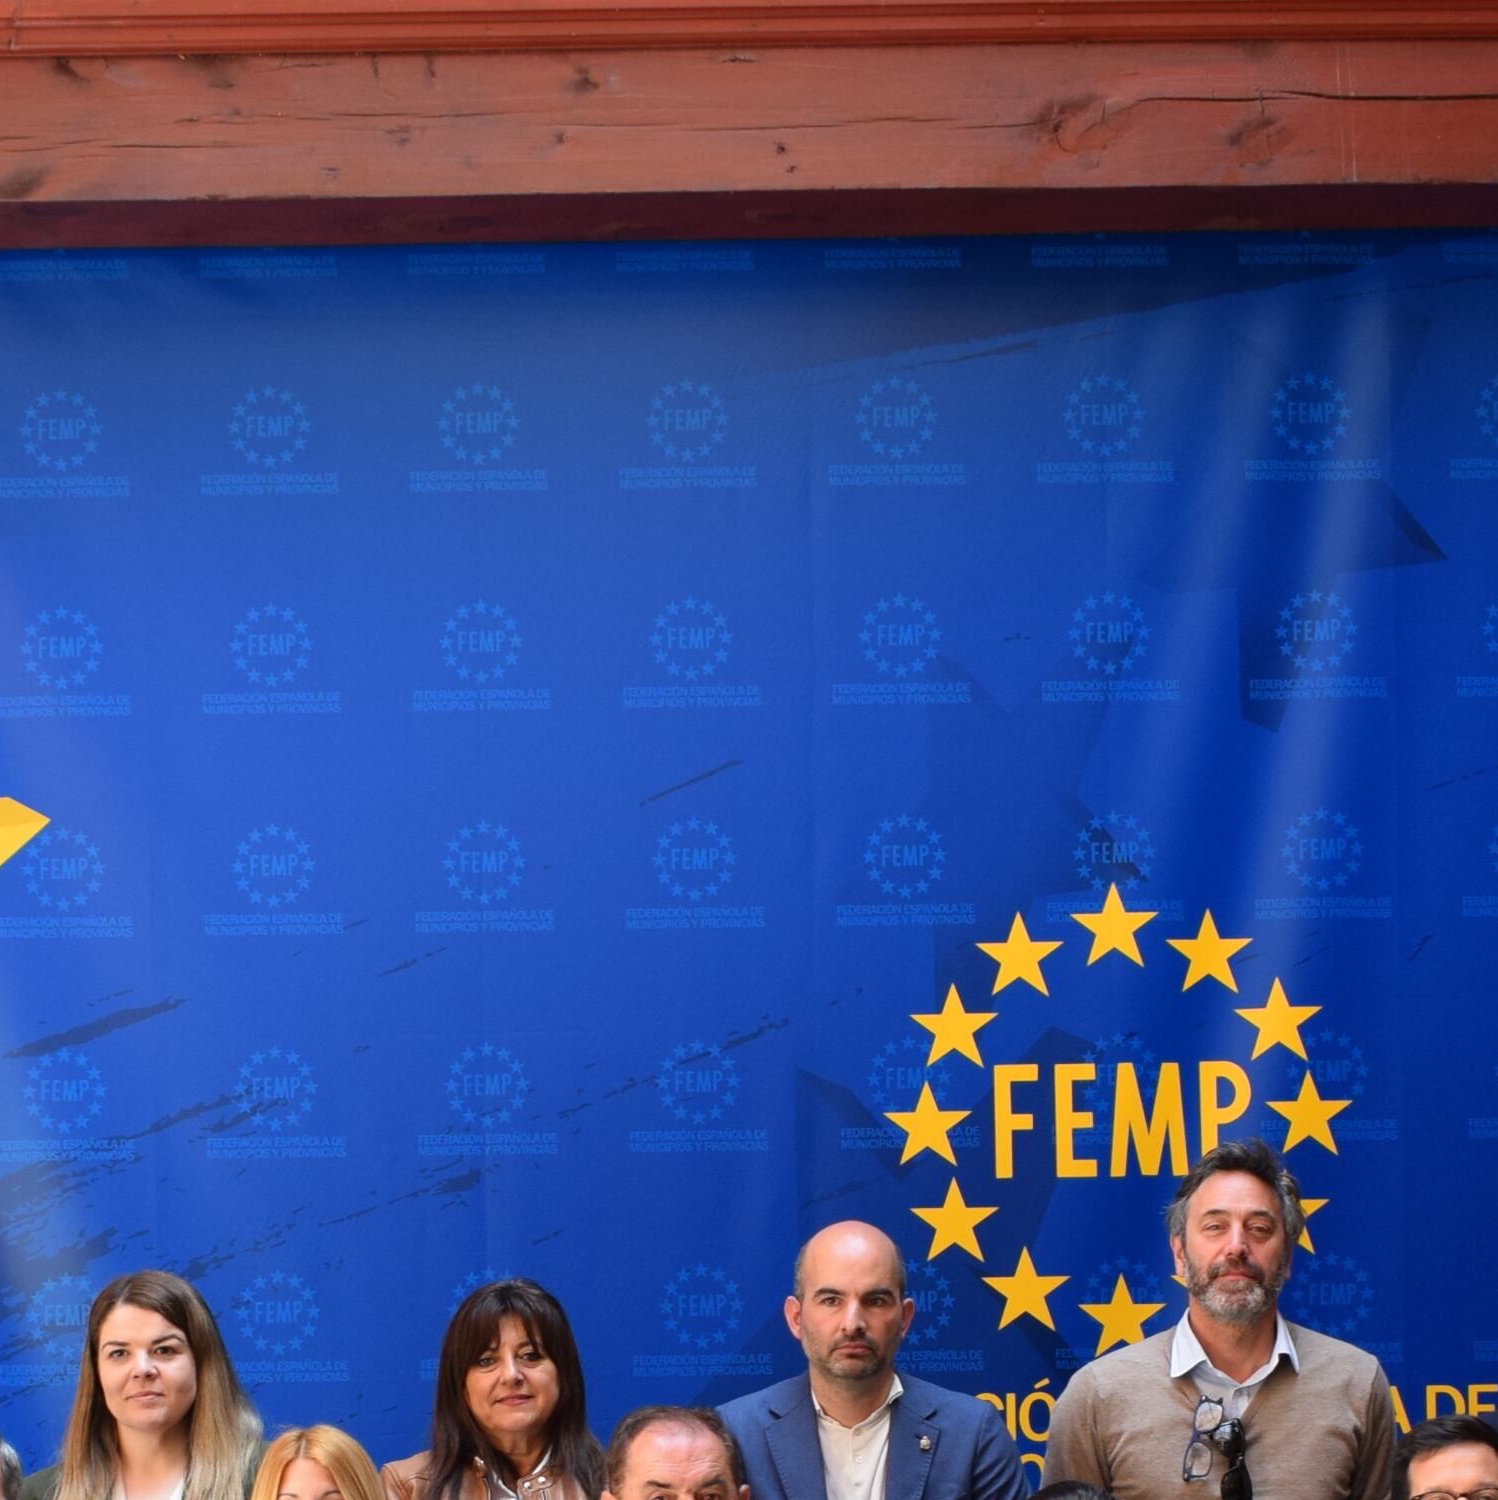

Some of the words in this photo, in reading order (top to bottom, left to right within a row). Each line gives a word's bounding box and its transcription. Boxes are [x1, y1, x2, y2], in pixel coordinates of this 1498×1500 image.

[455, 412, 503, 433] FEMP
[664, 409, 711, 430] FEMP
[872, 406, 920, 427] FEMP
[1080, 404, 1128, 425] FEMP
[1287, 402, 1334, 423] FEMP
[37, 418, 85, 440] FEMP
[246, 415, 294, 437] FEMP
[457, 630, 505, 652] FEMP
[667, 627, 715, 649] FEMP
[877, 624, 924, 646] FEMP
[1086, 621, 1133, 643] FEMP
[1293, 619, 1341, 641] FEMP
[38, 636, 86, 658] FEMP
[248, 634, 295, 655] FEMP
[671, 848, 719, 869] FEMP
[881, 844, 929, 866] FEMP
[1090, 841, 1138, 863] FEMP
[1298, 838, 1346, 859] FEMP
[40, 858, 88, 879] FEMP
[250, 854, 298, 876] FEMP
[460, 851, 508, 873] FEMP
[328, 912, 343, 923] DE
[539, 909, 554, 919] DE
[750, 906, 765, 916] DE
[959, 902, 974, 913] DE
[118, 915, 133, 926] DE
[41, 1080, 89, 1102] FEMP
[252, 1077, 300, 1099] FEMP
[463, 1074, 511, 1095] FEMP
[674, 1070, 723, 1092] FEMP
[994, 1060, 1253, 1179] FEMP
[331, 1135, 346, 1146] DE
[542, 1132, 557, 1143] DE
[753, 1129, 769, 1139] DE
[678, 1294, 726, 1316] FEMP
[1308, 1283, 1356, 1305] FEMP
[255, 1301, 303, 1323] FEMP
[1426, 1384, 1498, 1420] DE
